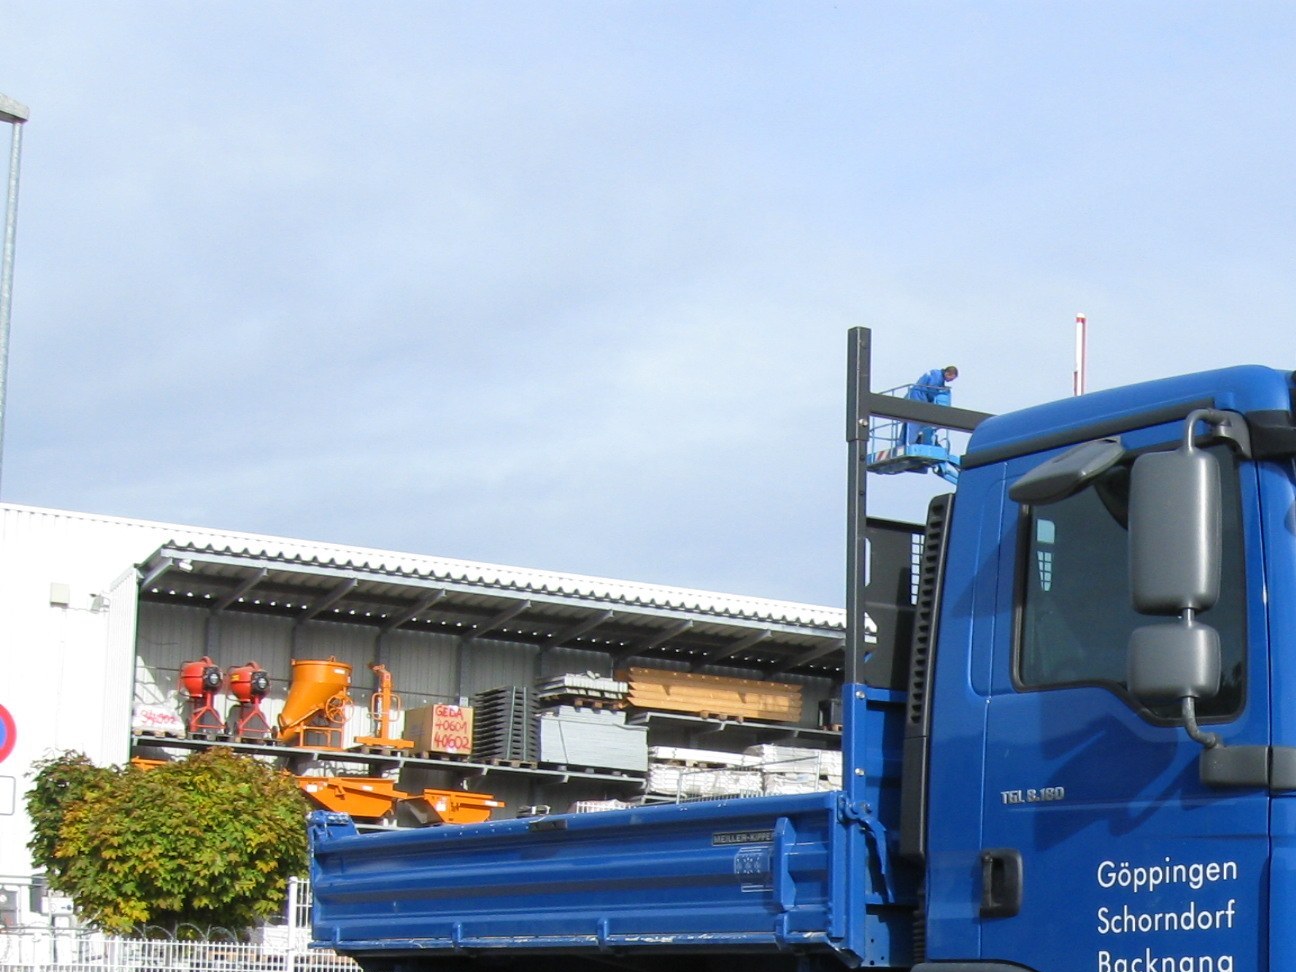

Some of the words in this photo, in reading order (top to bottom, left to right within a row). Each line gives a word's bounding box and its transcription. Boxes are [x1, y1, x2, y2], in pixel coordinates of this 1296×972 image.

[1000, 790, 1025, 804] TGL
[1026, 786, 1065, 803] 8.180
[714, 832, 774, 843] MEILLER-KIPPE
[1096, 857, 1238, 892] Göppingen
[1097, 898, 1236, 935] Schorndorf
